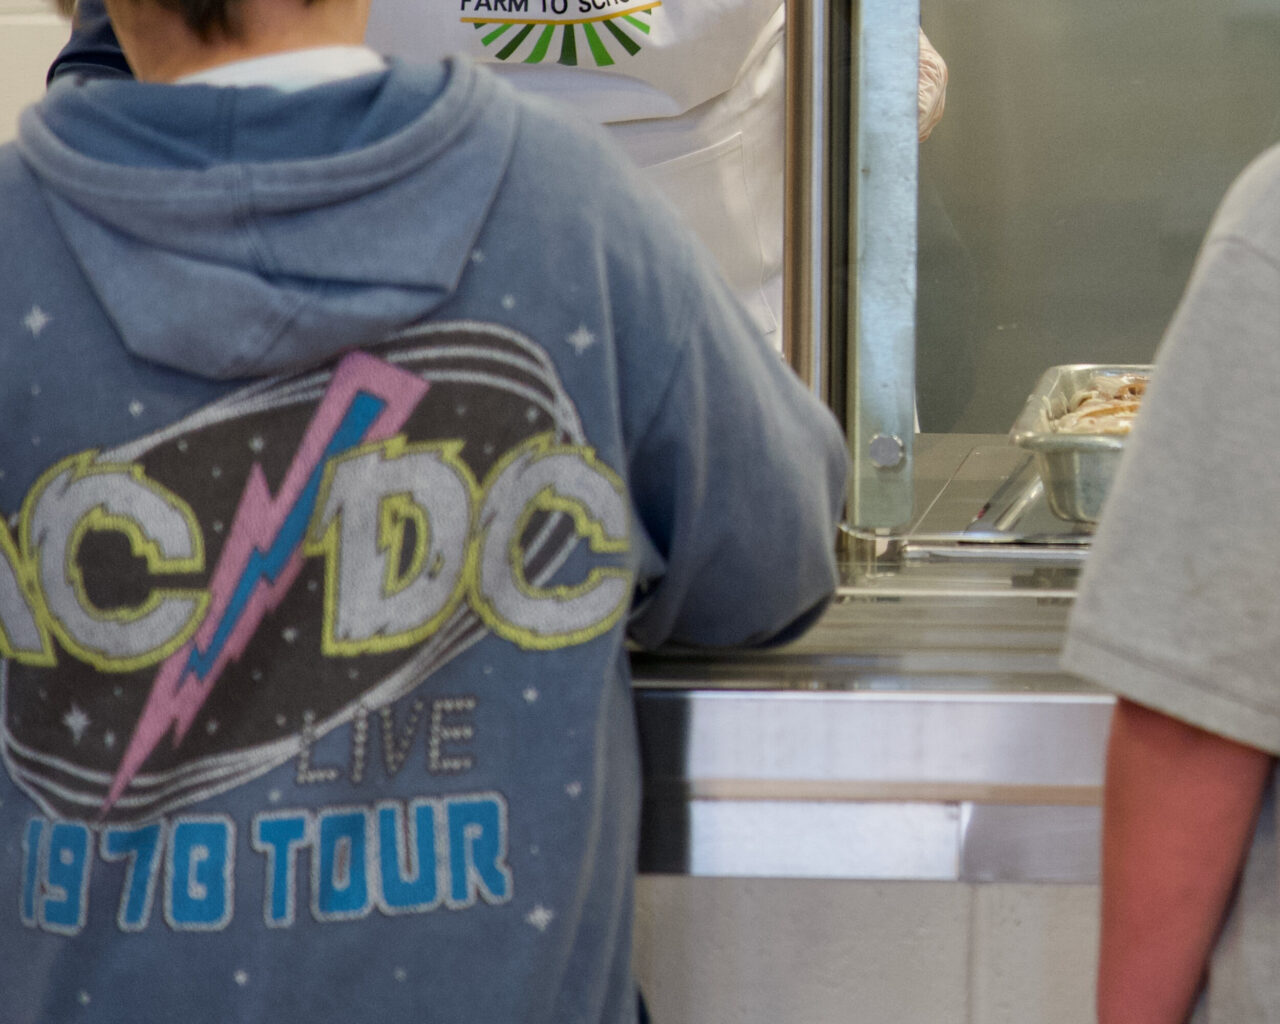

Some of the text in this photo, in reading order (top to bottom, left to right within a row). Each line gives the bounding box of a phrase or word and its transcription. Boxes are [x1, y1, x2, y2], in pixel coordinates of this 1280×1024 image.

[297, 696, 477, 785] LIVE
[19, 791, 513, 936] 1978 TOUR
